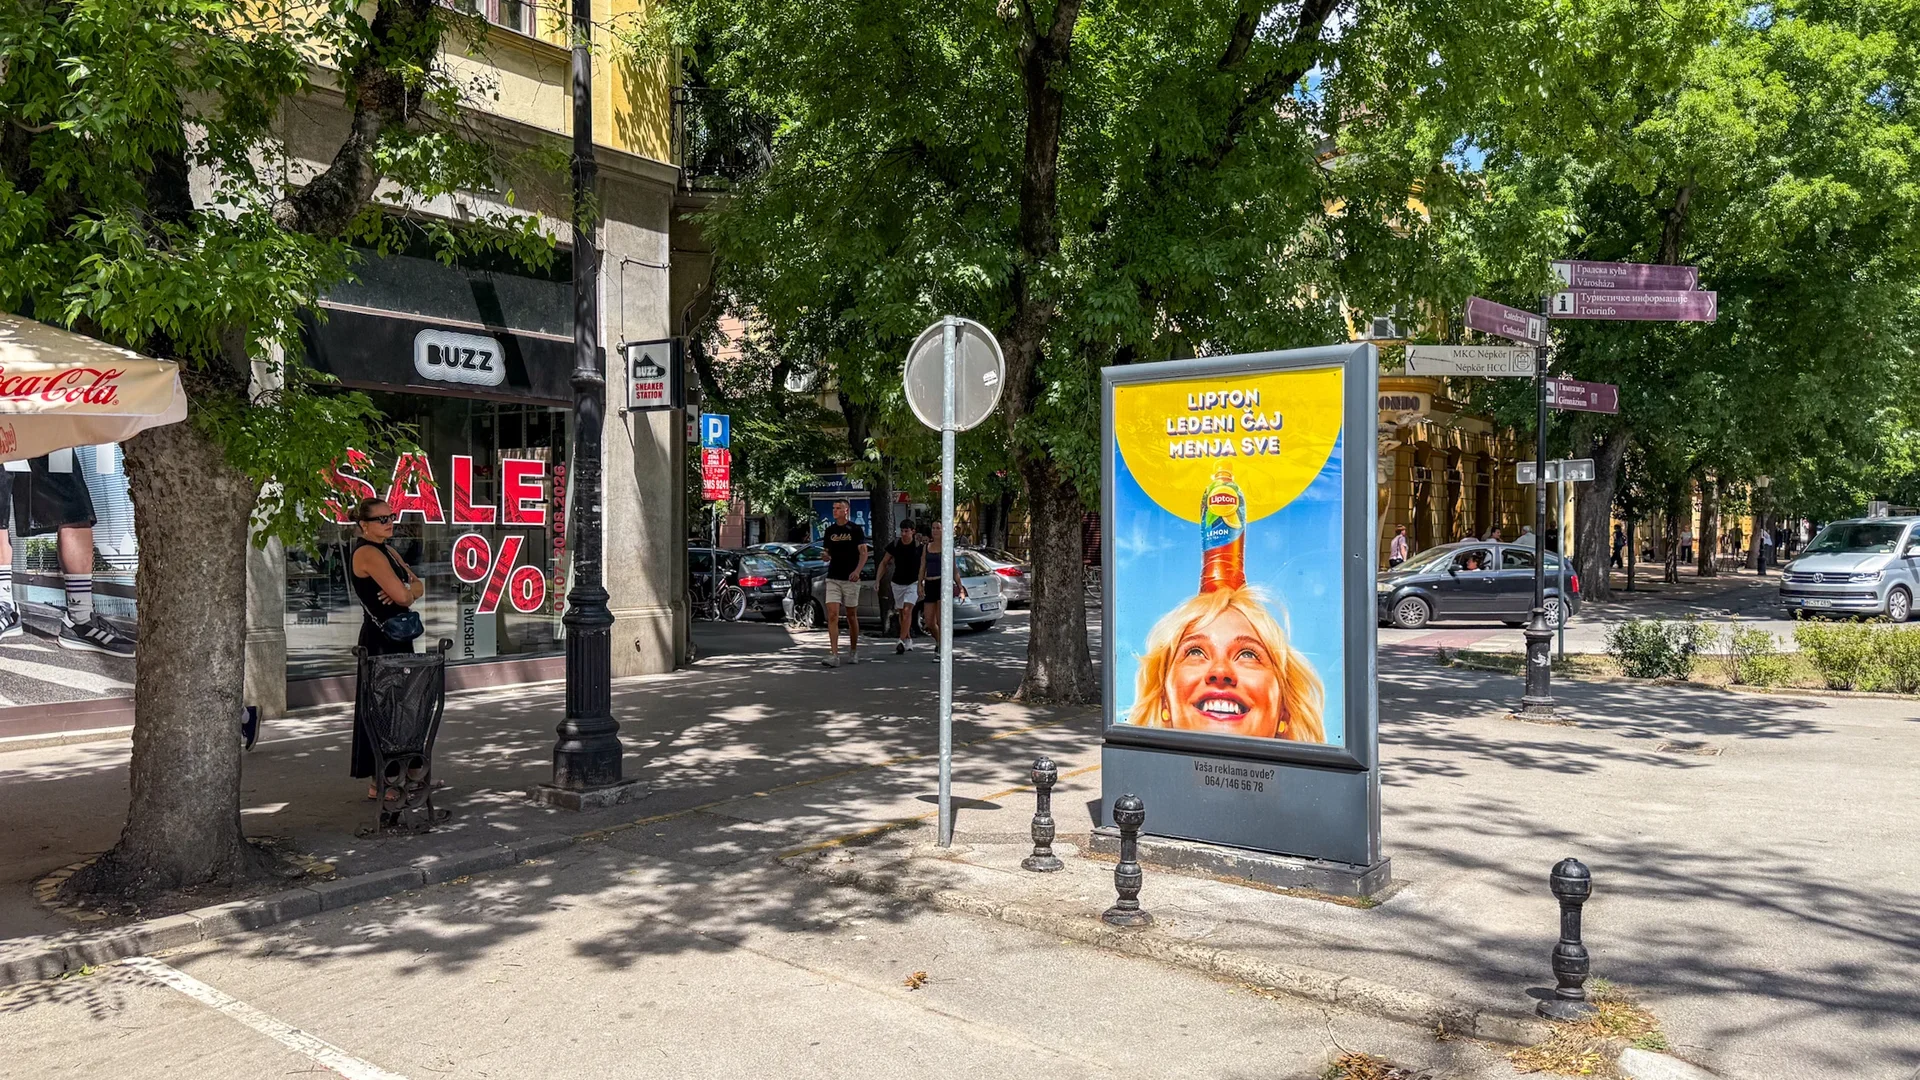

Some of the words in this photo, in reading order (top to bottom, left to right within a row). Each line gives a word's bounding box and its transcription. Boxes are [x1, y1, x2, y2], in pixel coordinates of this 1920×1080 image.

[1577, 278, 1615, 288] Városháza
[1580, 293, 1630, 304] Туристичке
[1632, 294, 1688, 305] информације
[1580, 306, 1616, 316] Tourinfo
[426, 343, 494, 372] BUZZ
[1453, 350, 1476, 359] MKC
[1477, 349, 1507, 361] Népkör
[636, 365, 659, 377] BUZZ
[1455, 362, 1485, 374] Népkör
[1486, 364, 1507, 372] HCC
[0, 365, 126, 405] ca-Cola
[635, 382, 664, 391] SNEAKER
[636, 391, 663, 399] STATION
[1187, 388, 1260, 410] LIPTON
[1378, 396, 1420, 410] ONDO
[1166, 414, 1235, 435] LEDENI
[1240, 408, 1283, 431] ČAJ
[708, 417, 723, 445] P
[1169, 438, 1237, 459] MENJA
[1241, 436, 1281, 455] SVE
[317, 447, 546, 526] SALE
[703, 479, 715, 489] SMS
[1210, 494, 1236, 504] Lipton
[1206, 528, 1229, 537] LEMON
[463, 607, 476, 659] UPERSTAR
[1194, 760, 1213, 772] Vaša
[1214, 763, 1248, 777] reklama
[1249, 767, 1275, 780] ovde?
[1204, 775, 1240, 789] 064/146
[1240, 779, 1252, 791] 56
[1252, 781, 1264, 792] 78
